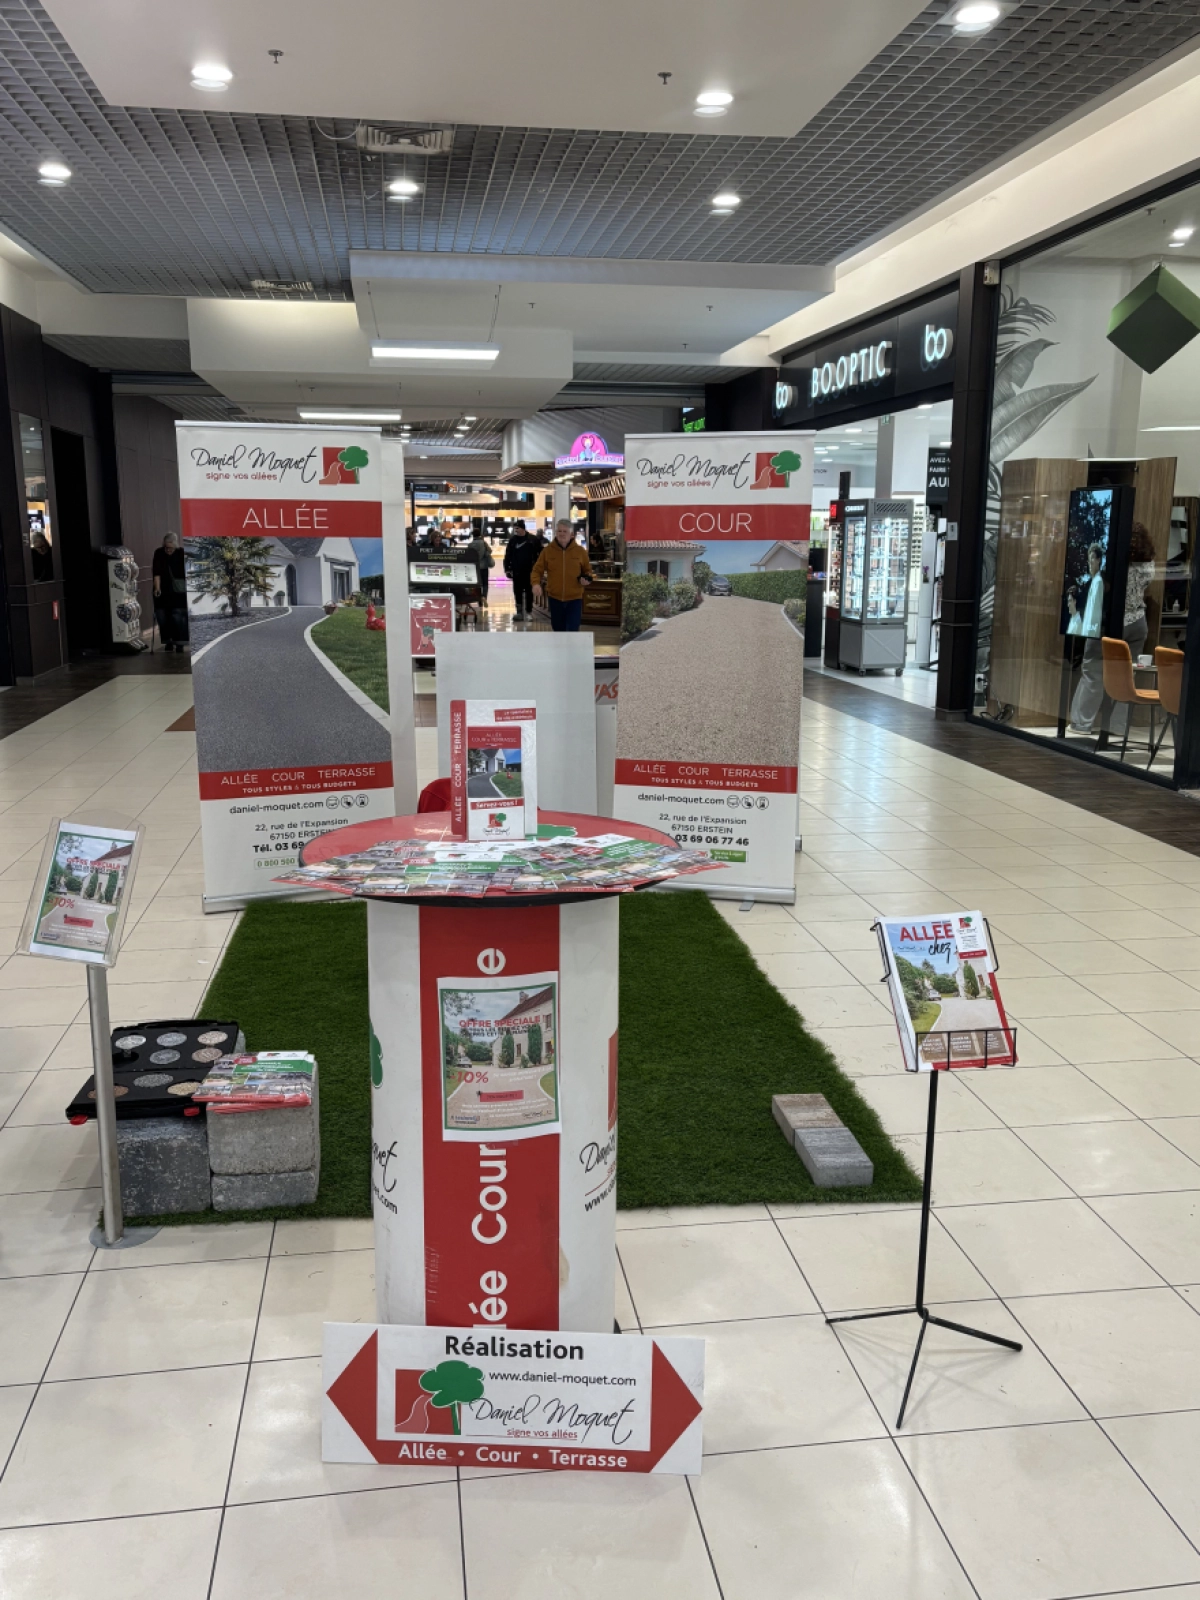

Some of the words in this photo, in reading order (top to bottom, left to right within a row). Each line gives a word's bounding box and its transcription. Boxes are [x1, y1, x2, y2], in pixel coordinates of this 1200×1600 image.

[811, 341, 892, 398] BO.OPTIC
[190, 444, 247, 471] Daniel
[248, 446, 317, 483] Moquet
[636, 454, 686, 479] Daniel
[686, 452, 751, 489] Moquet
[206, 472, 230, 481] signe
[251, 471, 278, 480] allées
[647, 480, 669, 489] signe
[686, 479, 711, 487] allées
[242, 504, 329, 529] ALLÉE
[679, 512, 752, 533] COUR
[453, 712, 462, 754] TERRASSE
[220, 773, 258, 785] ALLÉE
[272, 771, 305, 783] COUR
[317, 767, 376, 779] TERRASSE
[454, 763, 462, 788] COUR
[633, 763, 666, 774] ALLÉE
[678, 766, 709, 776] COUR
[722, 768, 778, 780] TERRASSE
[322, 780, 357, 788] BUDGETS
[229, 799, 324, 815] daniel-moquet.com
[637, 793, 725, 806] daniel-moquet.com
[254, 824, 268, 832] 22,
[287, 821, 298, 829] de
[300, 817, 348, 829] l'Expansion
[659, 814, 671, 822] 22,
[700, 815, 747, 827] l'Expansion
[269, 832, 296, 840] 67150
[671, 824, 695, 832] 67150
[697, 825, 733, 834] ERSTEIN
[252, 844, 273, 853] Tél.
[275, 842, 289, 851] 03
[291, 841, 304, 850] 69
[674, 834, 688, 843] 03
[690, 835, 703, 844] 69
[705, 835, 719, 844] 06
[721, 836, 733, 845] 77
[735, 837, 749, 846] 46
[928, 936, 951, 964] chez
[459, 1019, 491, 1028] OFFRE
[449, 1071, 489, 1084] -10%
[472, 1144, 507, 1244] Cour
[445, 1336, 584, 1360] Réalisation
[489, 1371, 636, 1387] www.daniel-moquet.com
[469, 1394, 541, 1425] Daniel
[543, 1398, 635, 1444] Moquet
[507, 1428, 531, 1439] signe
[533, 1430, 549, 1438] vos
[551, 1429, 578, 1439] allées
[398, 1443, 447, 1460] Allée
[475, 1446, 521, 1463] Cour
[548, 1449, 628, 1468] Terrasse
